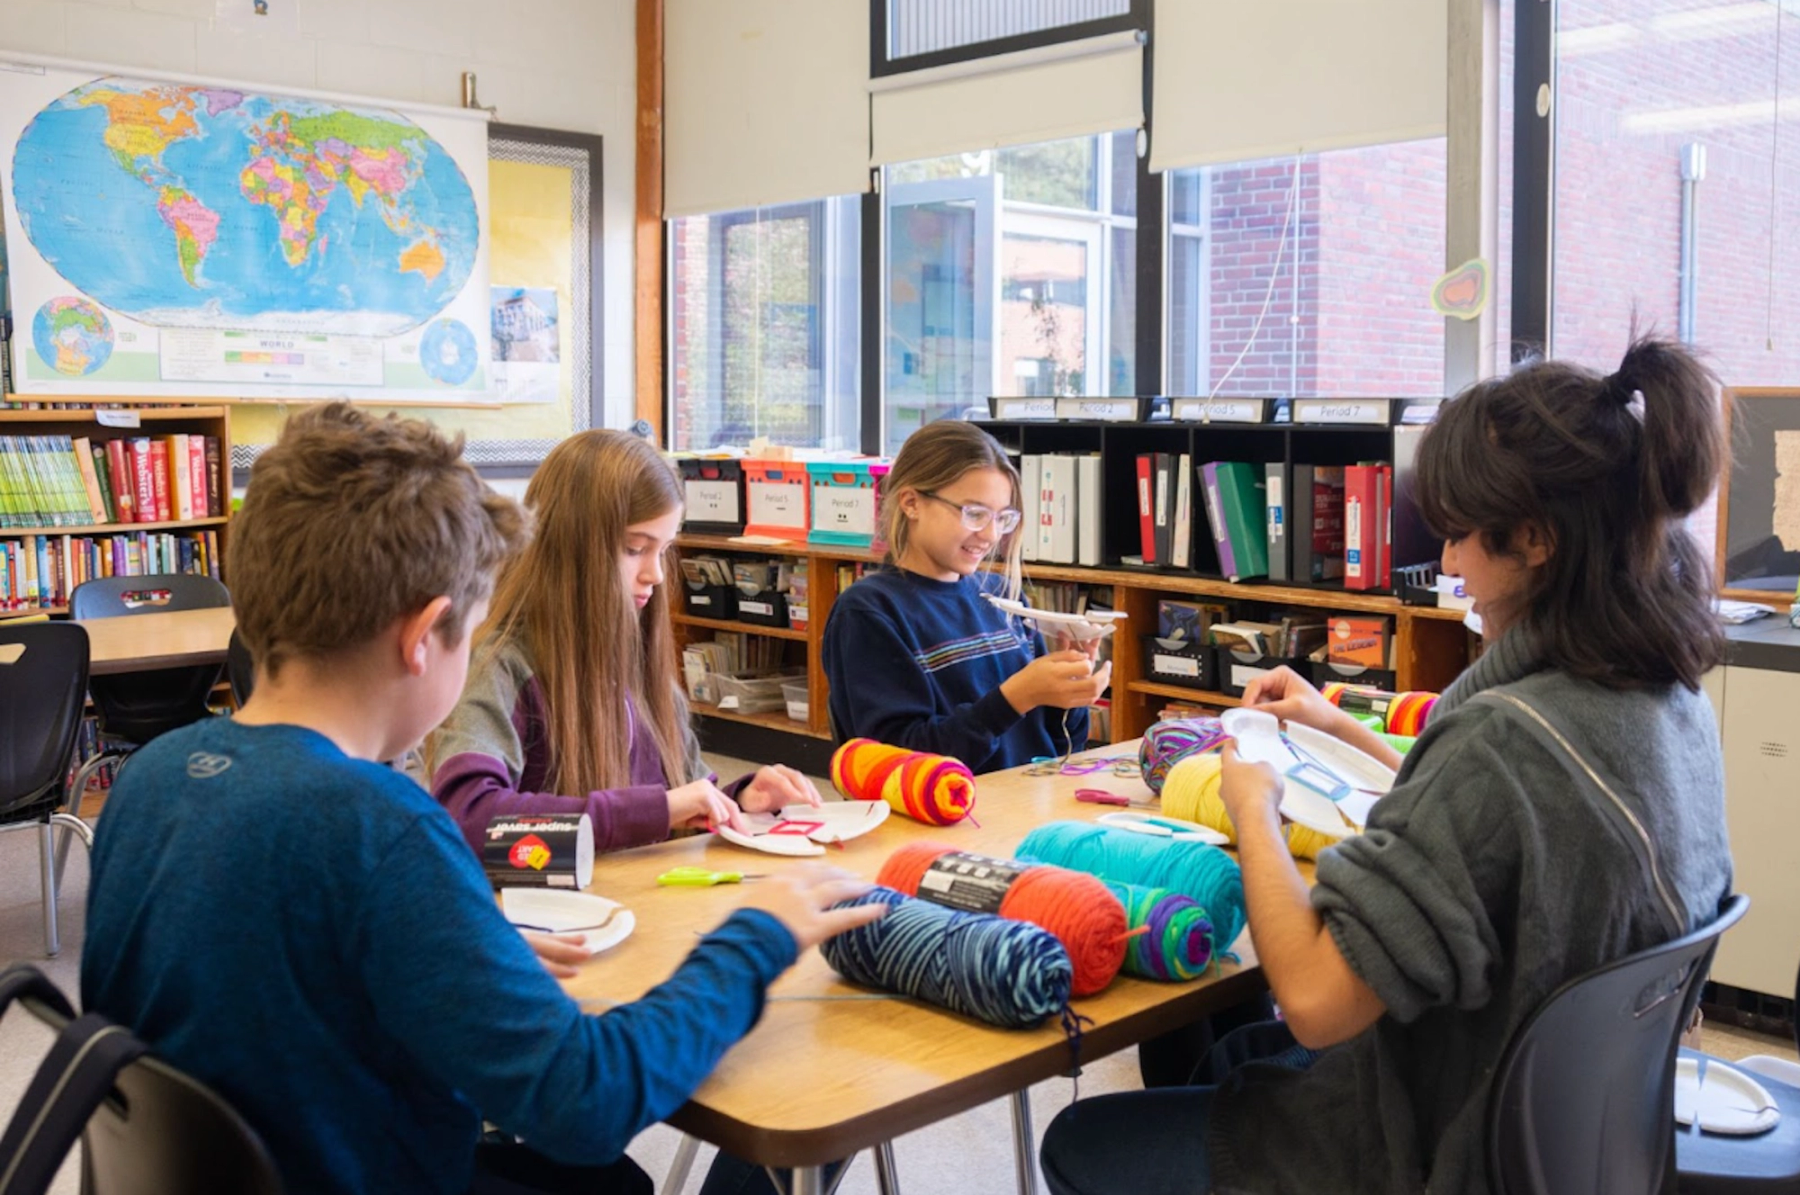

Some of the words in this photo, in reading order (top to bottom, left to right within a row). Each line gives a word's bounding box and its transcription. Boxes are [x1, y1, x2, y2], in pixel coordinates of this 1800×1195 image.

[260, 340, 295, 349] WORLD
[1079, 402, 1106, 414] Period
[1229, 404, 1237, 415] 5
[1320, 404, 1352, 417] Period
[1353, 405, 1361, 417] 7
[137, 453, 152, 505] Webster's
[700, 491, 717, 500] Period
[765, 493, 783, 502] Period
[832, 499, 854, 508] Period
[495, 822, 530, 832] saver
[535, 821, 572, 832] super
